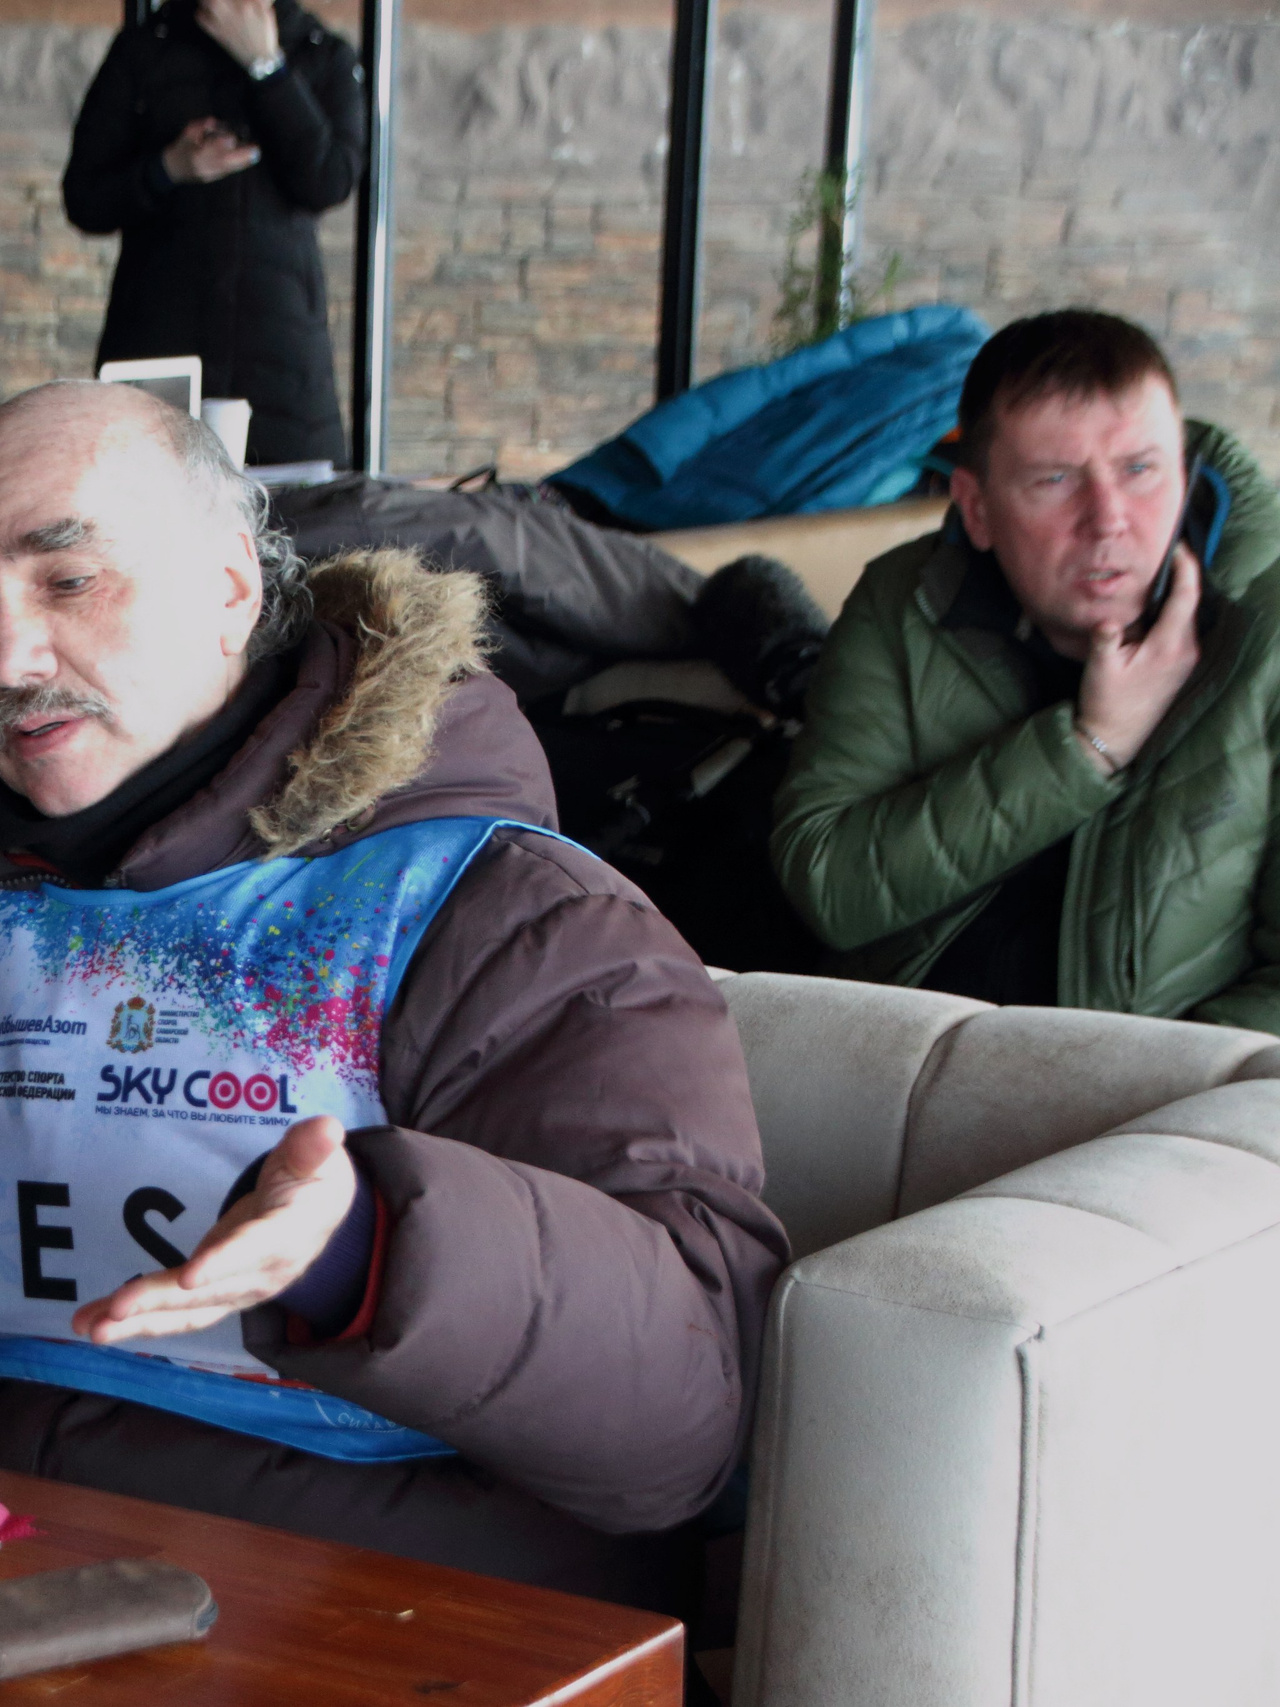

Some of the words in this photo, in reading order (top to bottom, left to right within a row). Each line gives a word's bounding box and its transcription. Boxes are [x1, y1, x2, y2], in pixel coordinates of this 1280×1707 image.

[28, 1070, 65, 1085] СПОРТА
[97, 1064, 177, 1105] SKY
[183, 1070, 297, 1114] COOL
[95, 1104, 111, 1115] МЫ
[114, 1105, 150, 1118] ЗНАЕМ,
[152, 1108, 166, 1118] ЗА
[168, 1109, 188, 1120] ЧТО
[190, 1111, 207, 1121] ВЫ
[209, 1112, 256, 1125] ЛЮБИТЕ
[258, 1115, 291, 1127] ЗИМУ
